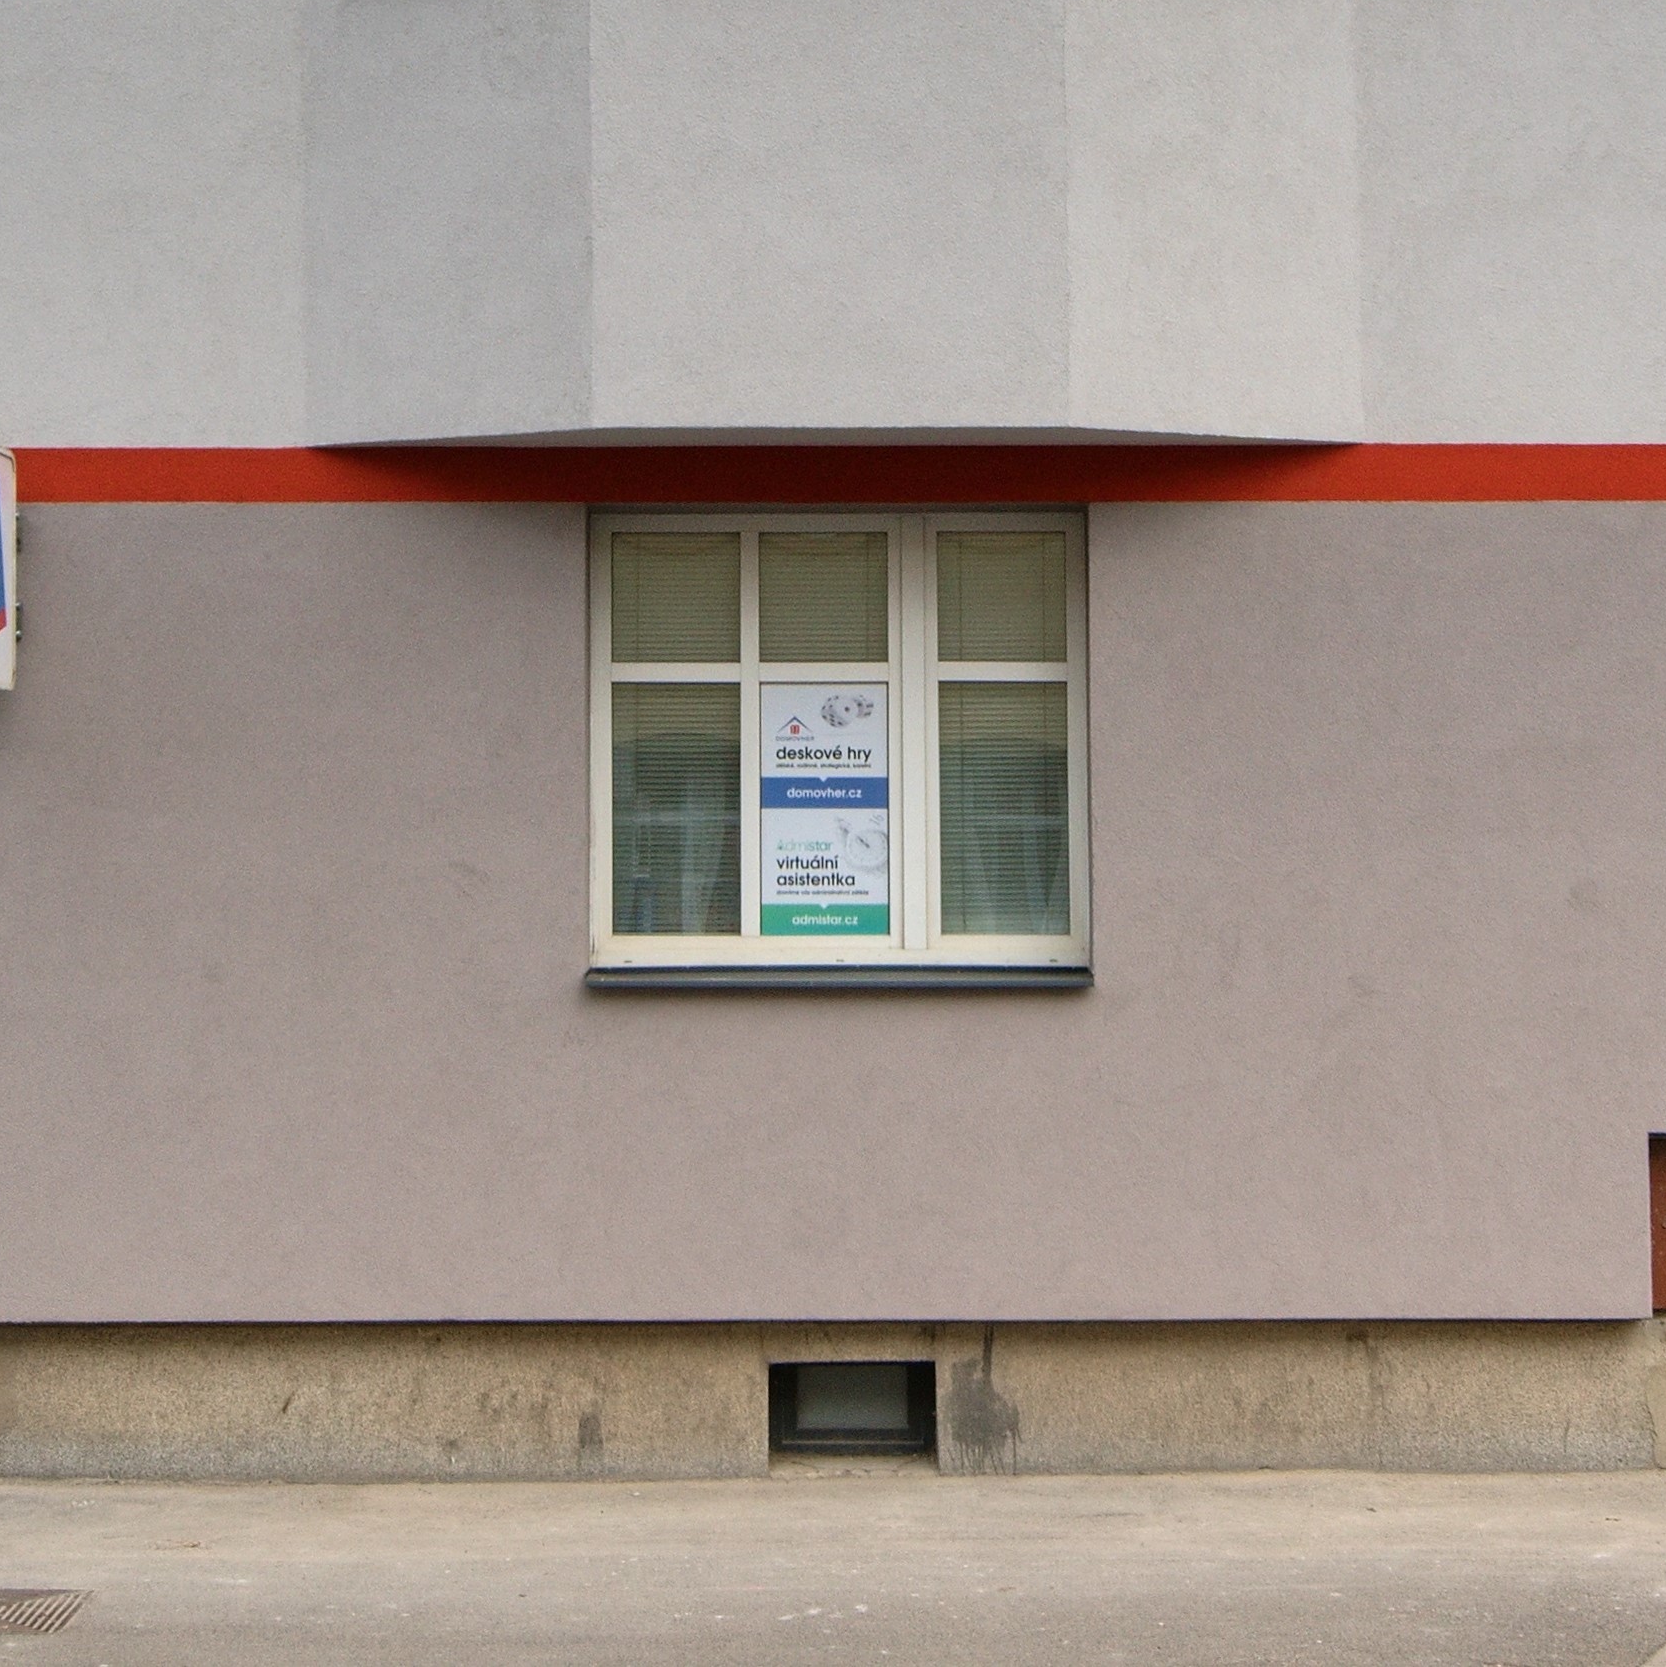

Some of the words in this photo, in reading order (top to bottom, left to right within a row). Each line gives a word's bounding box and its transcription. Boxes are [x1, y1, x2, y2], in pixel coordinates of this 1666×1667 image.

[776, 744, 843, 760] deskové
[847, 746, 872, 763] hry
[786, 787, 863, 799] domovher.cz
[776, 854, 839, 870] virtuální
[776, 872, 856, 887] asistentka
[792, 914, 859, 925] admistar.cz
